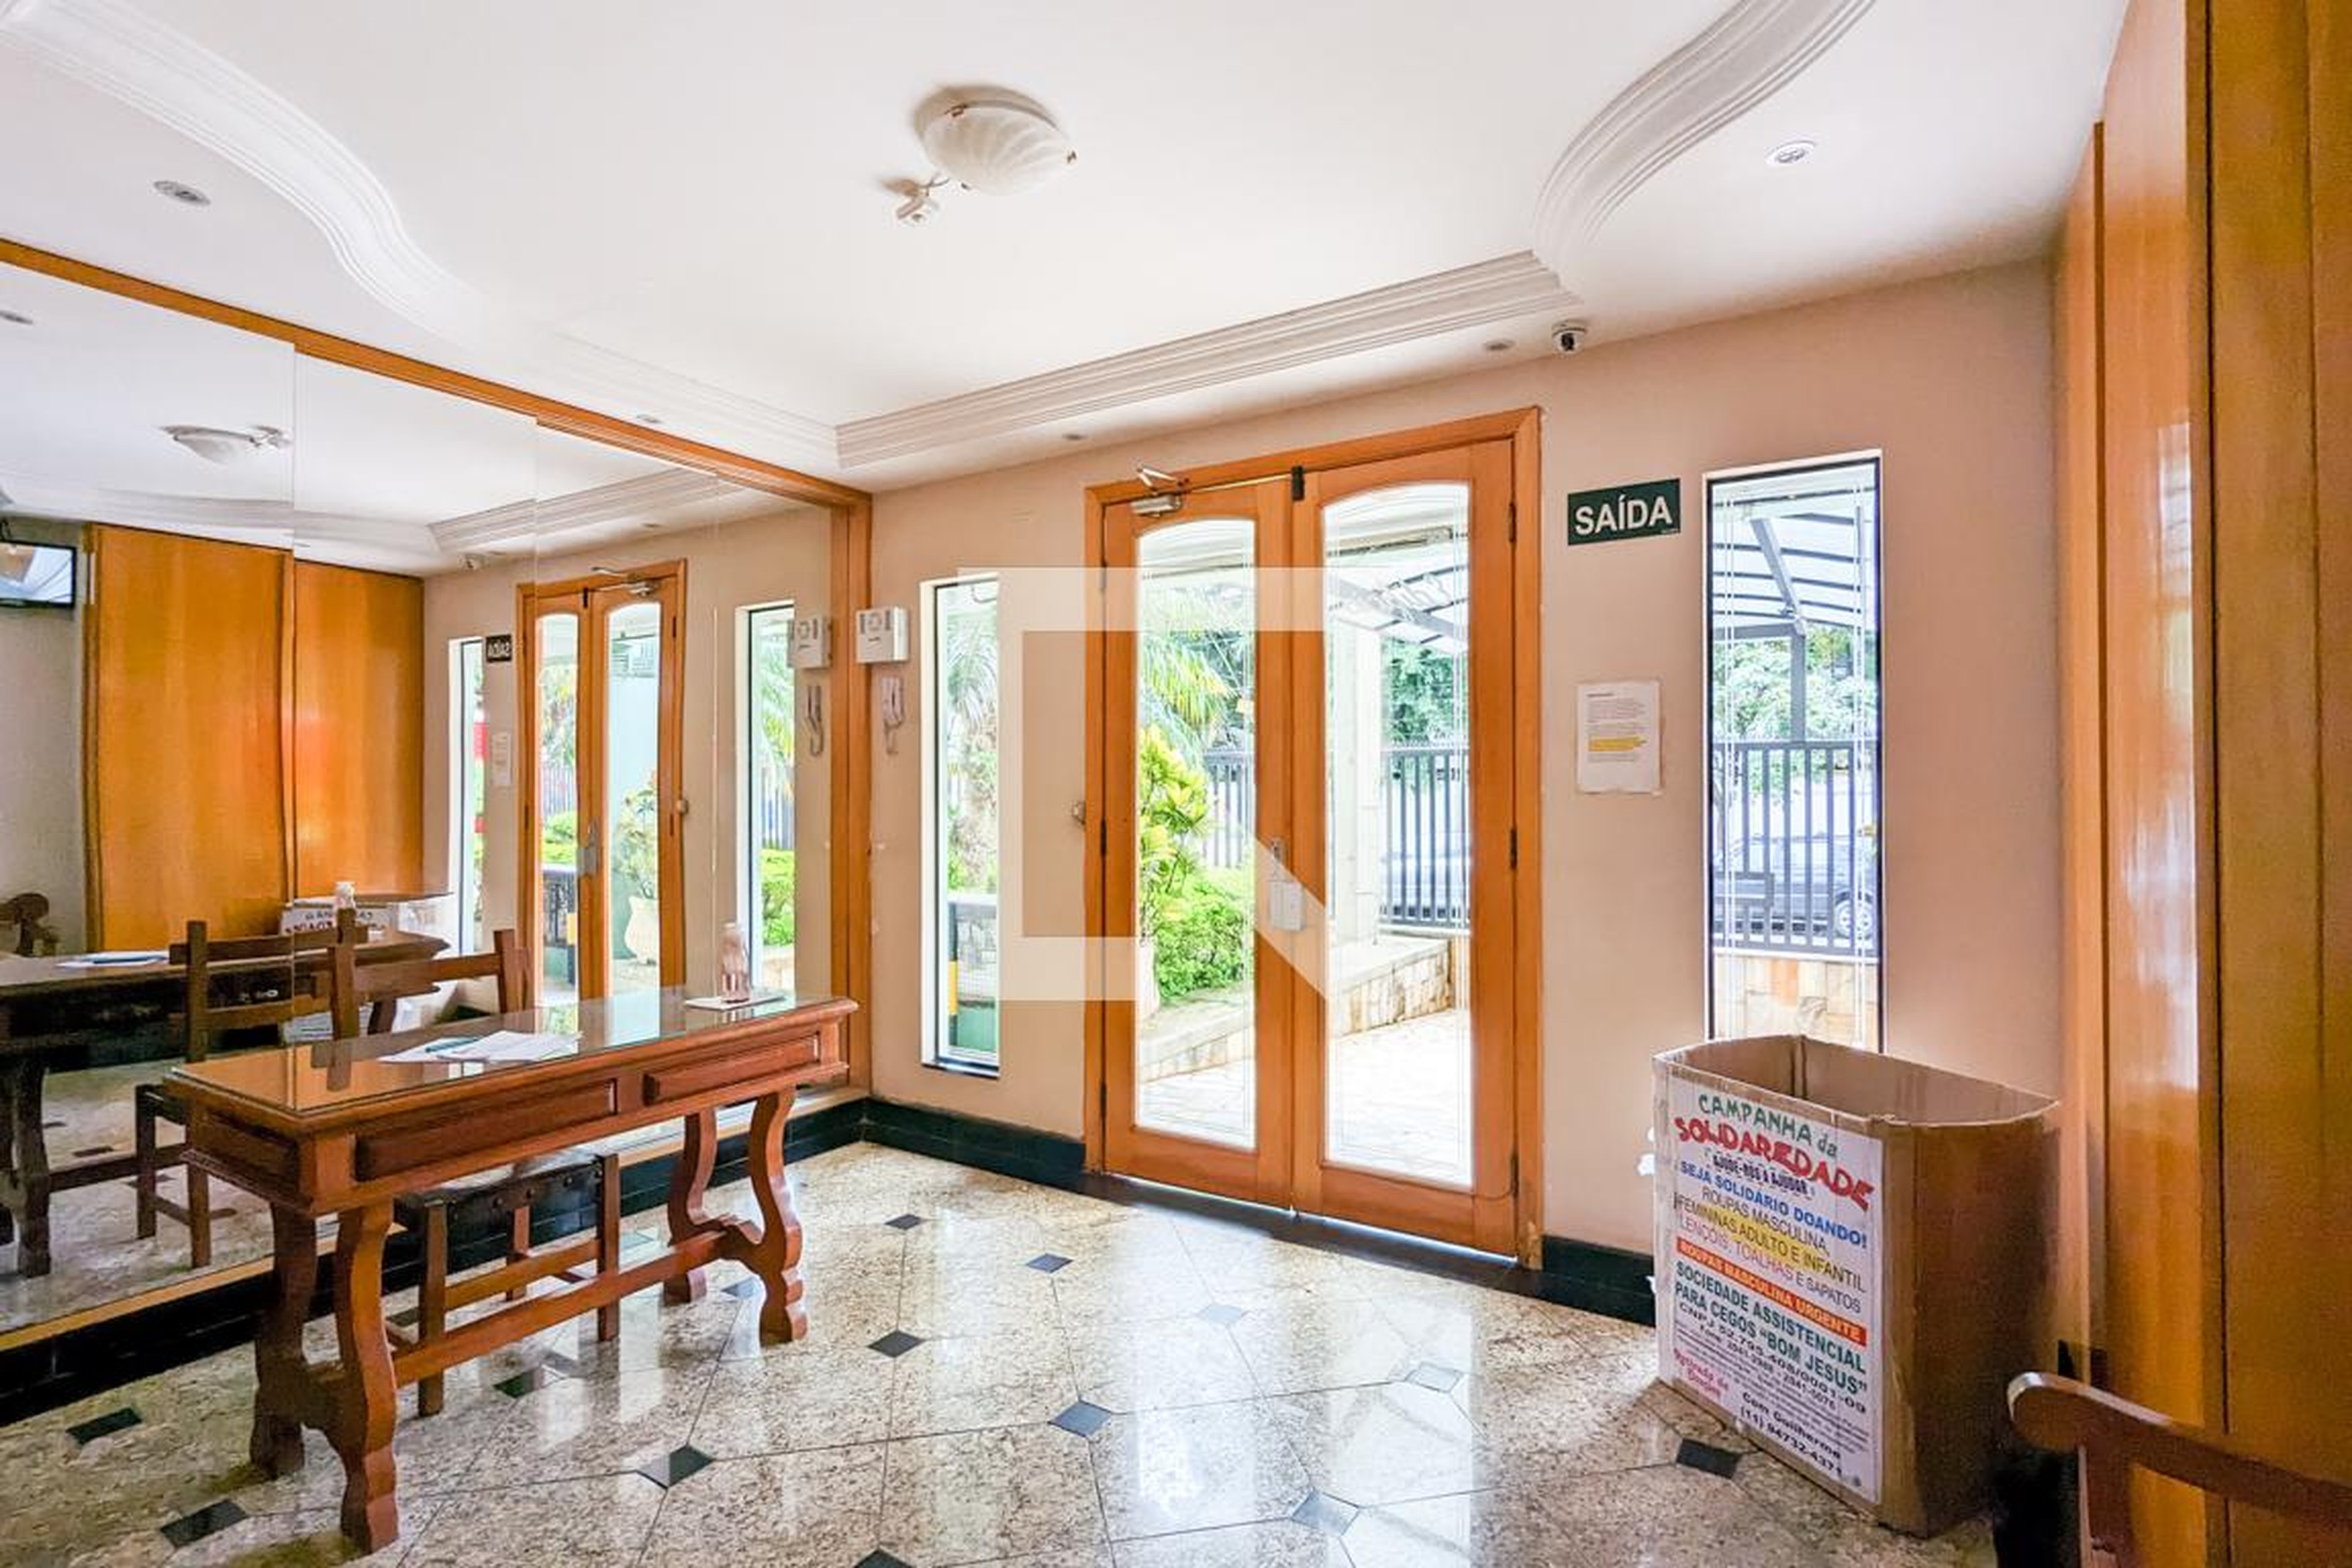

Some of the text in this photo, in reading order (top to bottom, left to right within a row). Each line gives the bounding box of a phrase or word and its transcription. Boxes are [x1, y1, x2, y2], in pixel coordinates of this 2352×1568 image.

[1575, 494, 1673, 535] SAÍDA
[1698, 1094, 1837, 1157] CAMPANHA da
[1681, 1161, 1713, 1185] SEJA
[1793, 1207, 1868, 1249] DOANDO!
[1702, 1185, 1749, 1218] ROUPAS
[1678, 1193, 1866, 1293] FEMININAS ADULTO E INFANTIL
[1735, 1241, 1793, 1281] TOALHAS
[1796, 1273, 1803, 1286] E
[1806, 1277, 1861, 1314] SAPATOS
[1675, 1281, 1707, 1311] PARA
[1710, 1302, 1757, 1339] CEGOS
[1675, 1261, 1866, 1375] SOCIEDADE ASSISTENCIAL
[1679, 1303, 1714, 1327] CNPJ
[1796, 1295, 1861, 1340] URGENTE
[1740, 1406, 1763, 1429] (11)
[1743, 1392, 1841, 1460] Com Guilherme
